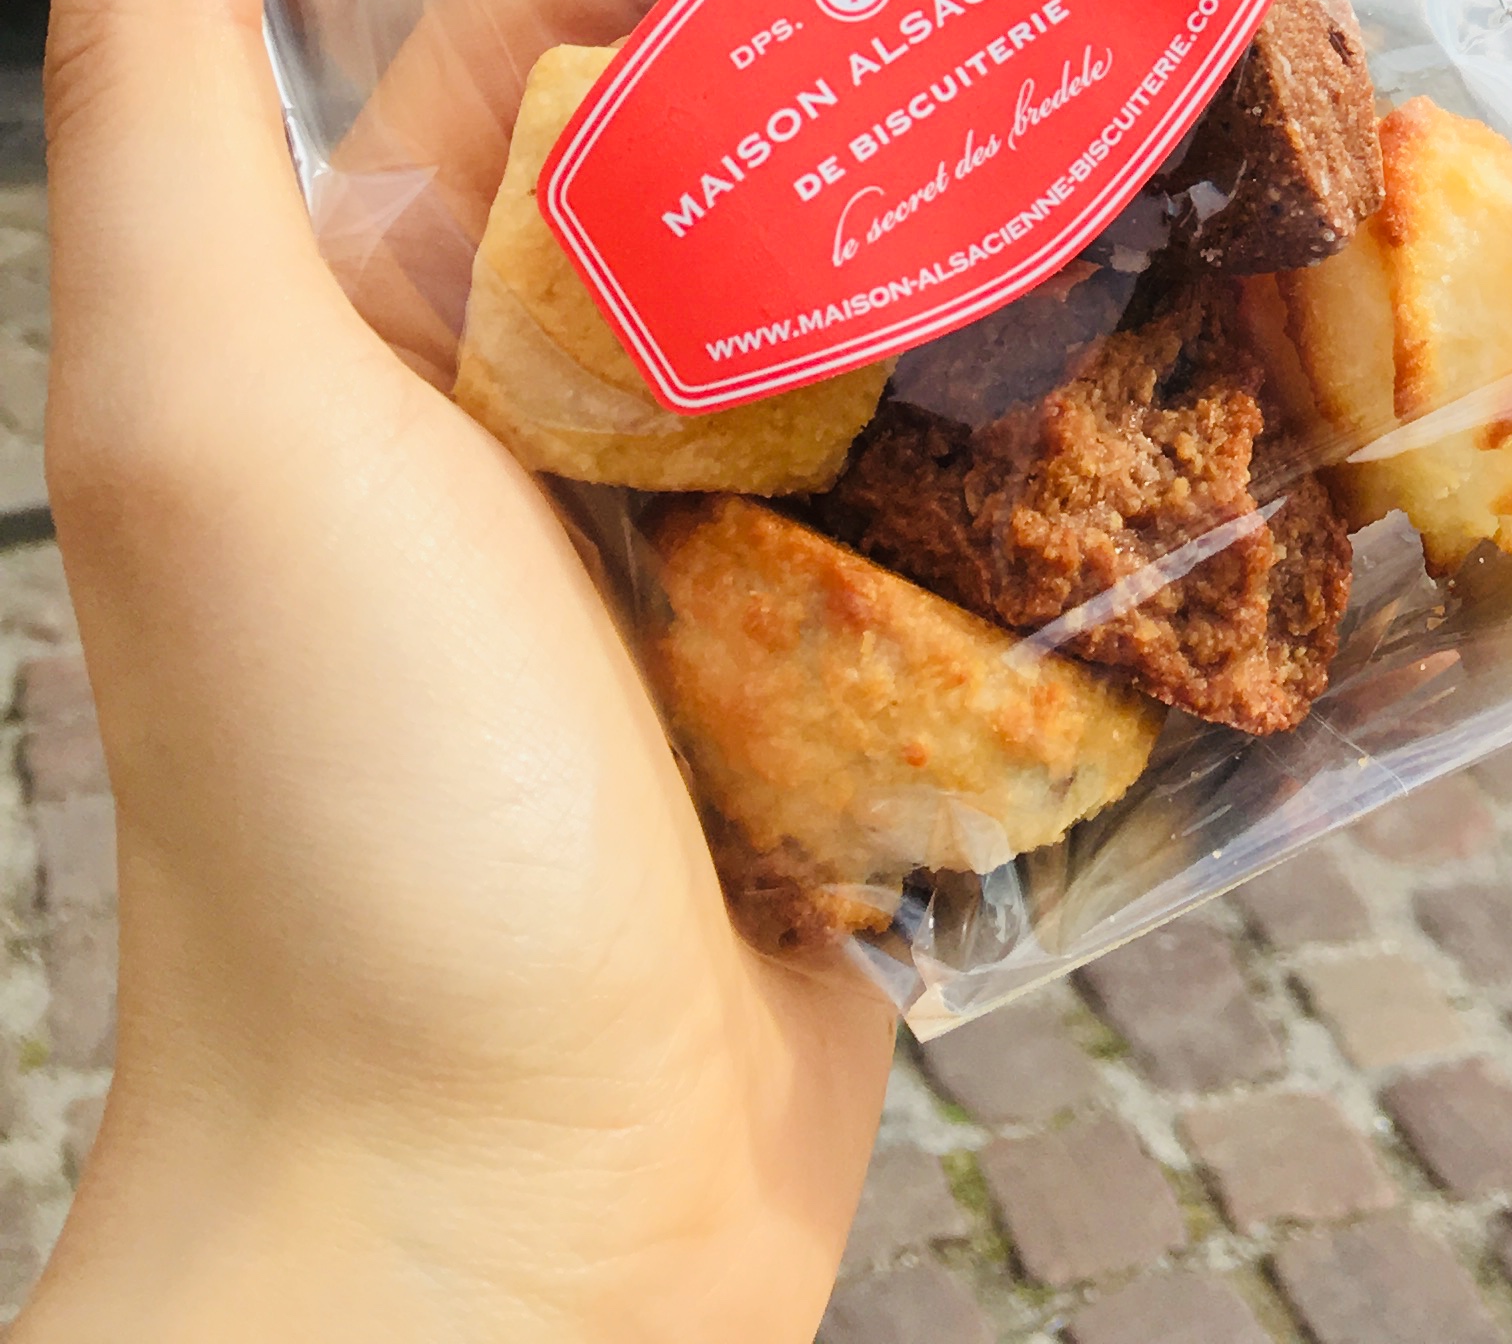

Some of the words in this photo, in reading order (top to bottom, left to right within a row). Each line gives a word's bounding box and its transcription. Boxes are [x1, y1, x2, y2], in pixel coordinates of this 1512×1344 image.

[730, 18, 803, 70] DPS.
[660, 77, 838, 238] MAISON
[793, 155, 846, 202] DE
[832, 185, 885, 267] le
[866, 161, 949, 243] secret
[955, 129, 1001, 179] des
[1008, 45, 1112, 150] bredele
